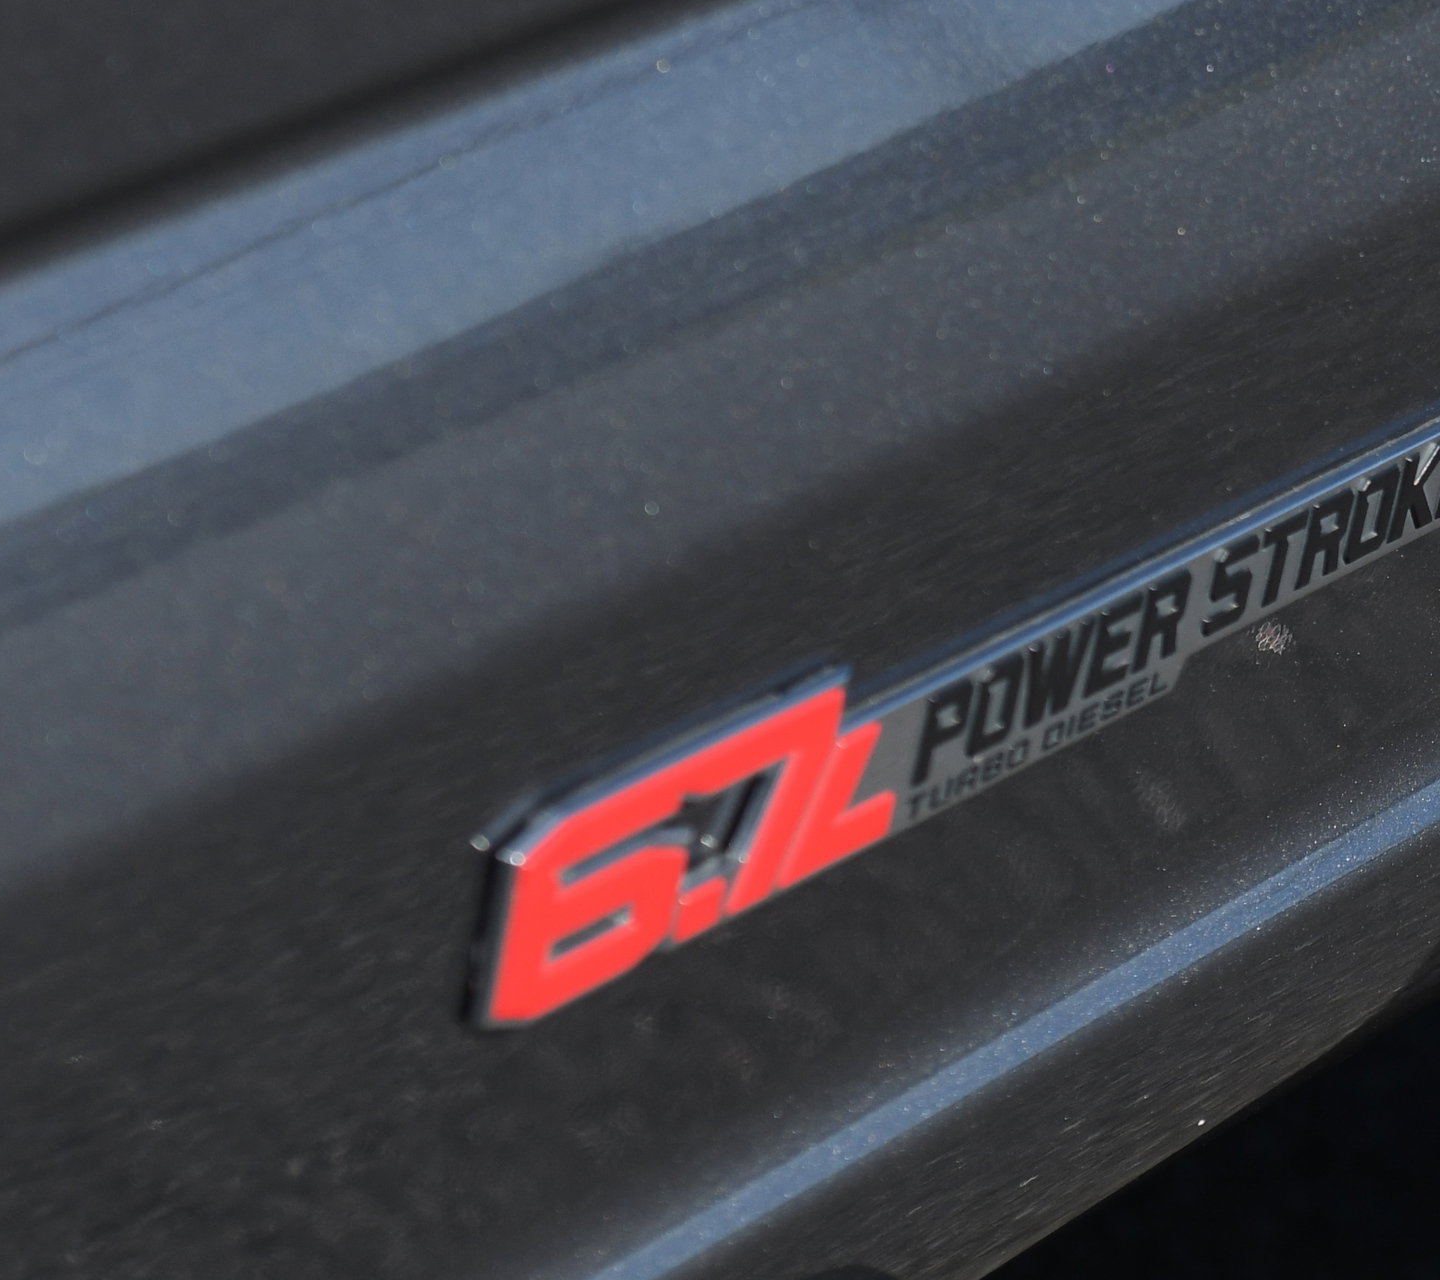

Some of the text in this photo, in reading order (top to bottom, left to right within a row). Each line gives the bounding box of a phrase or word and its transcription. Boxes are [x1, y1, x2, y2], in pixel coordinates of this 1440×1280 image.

[909, 673, 1167, 818] TURBO DIESEL
[911, 569, 1192, 787] POWER
[487, 685, 896, 1022] 6.7L
